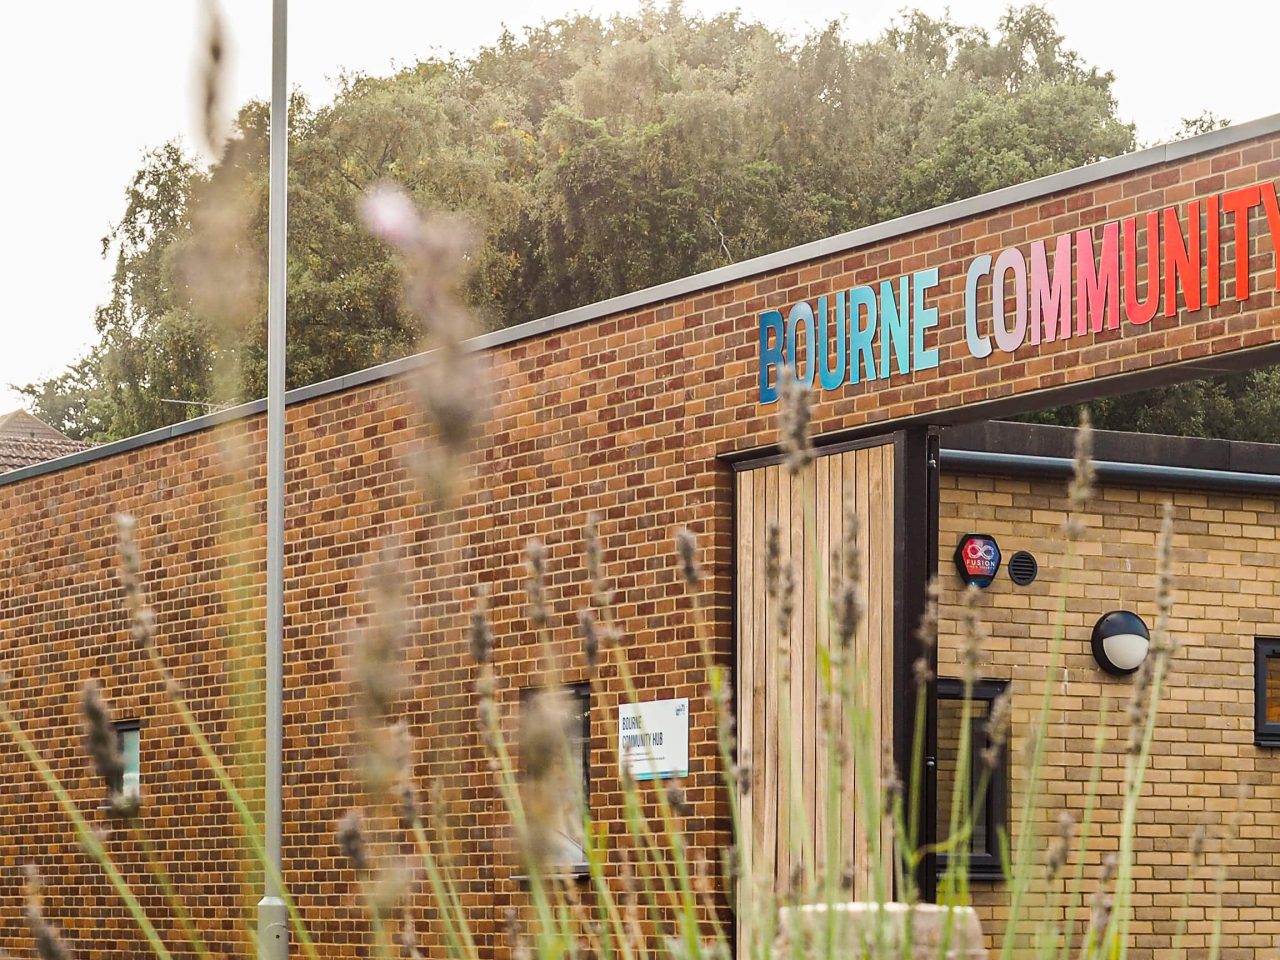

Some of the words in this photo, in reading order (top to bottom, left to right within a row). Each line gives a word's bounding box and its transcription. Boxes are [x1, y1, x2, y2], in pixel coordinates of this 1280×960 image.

[759, 266, 939, 404] BOURNE
[622, 715, 642, 731] BOURNE
[622, 733, 652, 749] COMMUNITY
[652, 732, 663, 746] HUB
